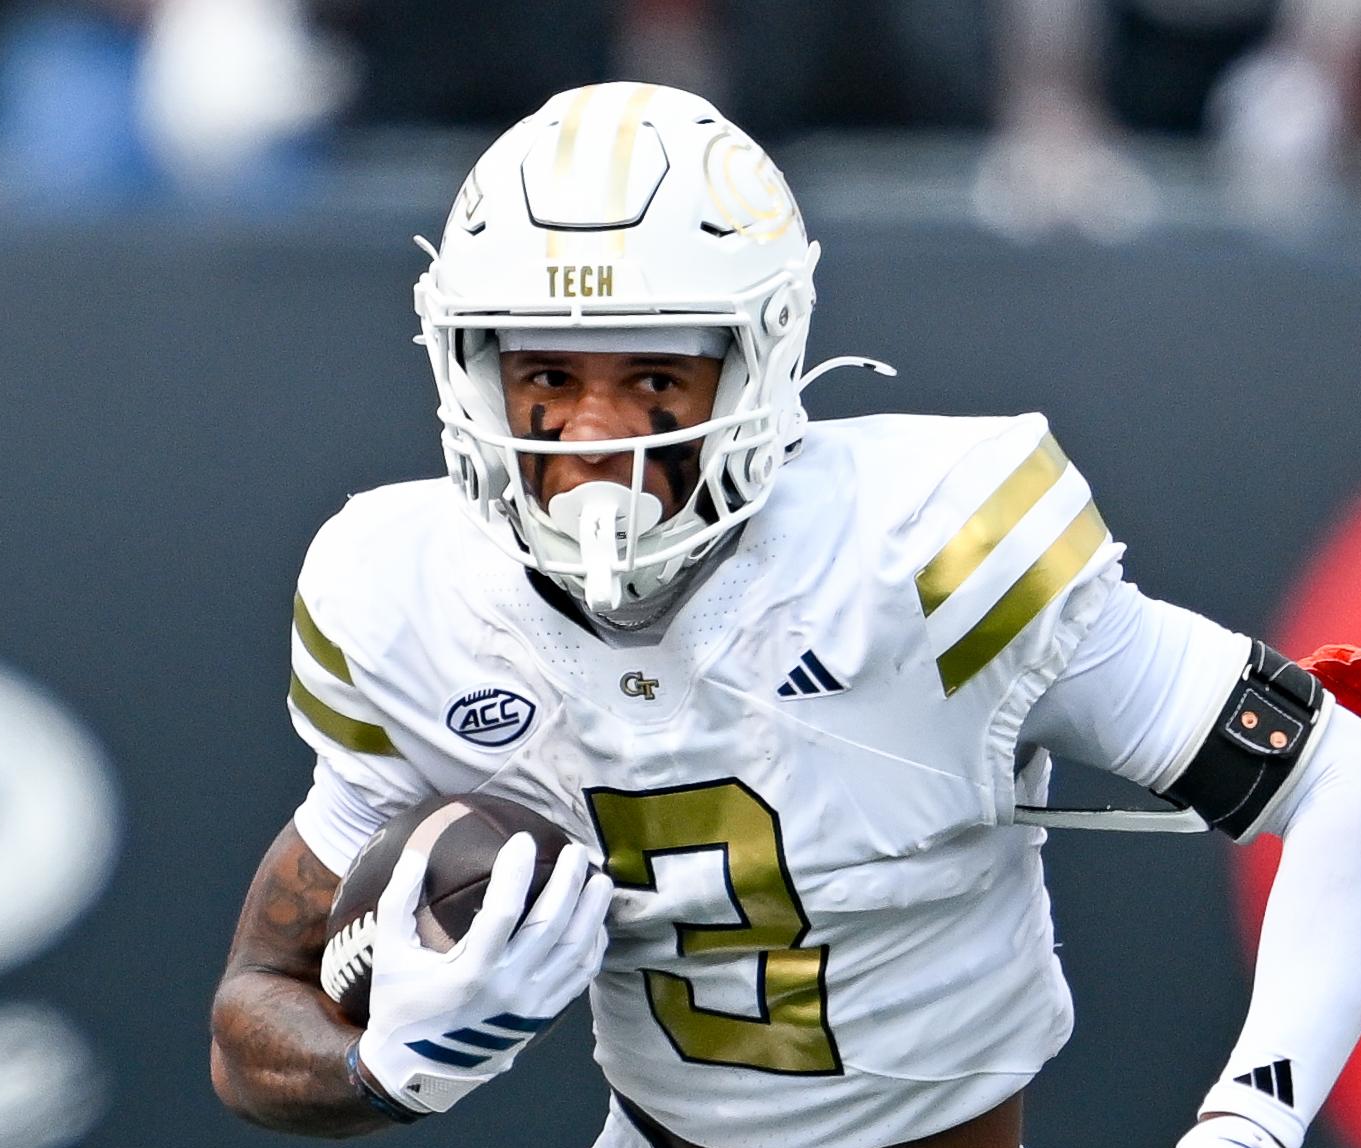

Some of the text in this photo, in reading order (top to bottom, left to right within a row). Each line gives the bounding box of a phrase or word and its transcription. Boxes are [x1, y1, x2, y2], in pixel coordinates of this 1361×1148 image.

[546, 265, 613, 297] TECH
[620, 671, 660, 701] GT
[458, 695, 520, 731] ACC
[581, 775, 845, 1076] 3
